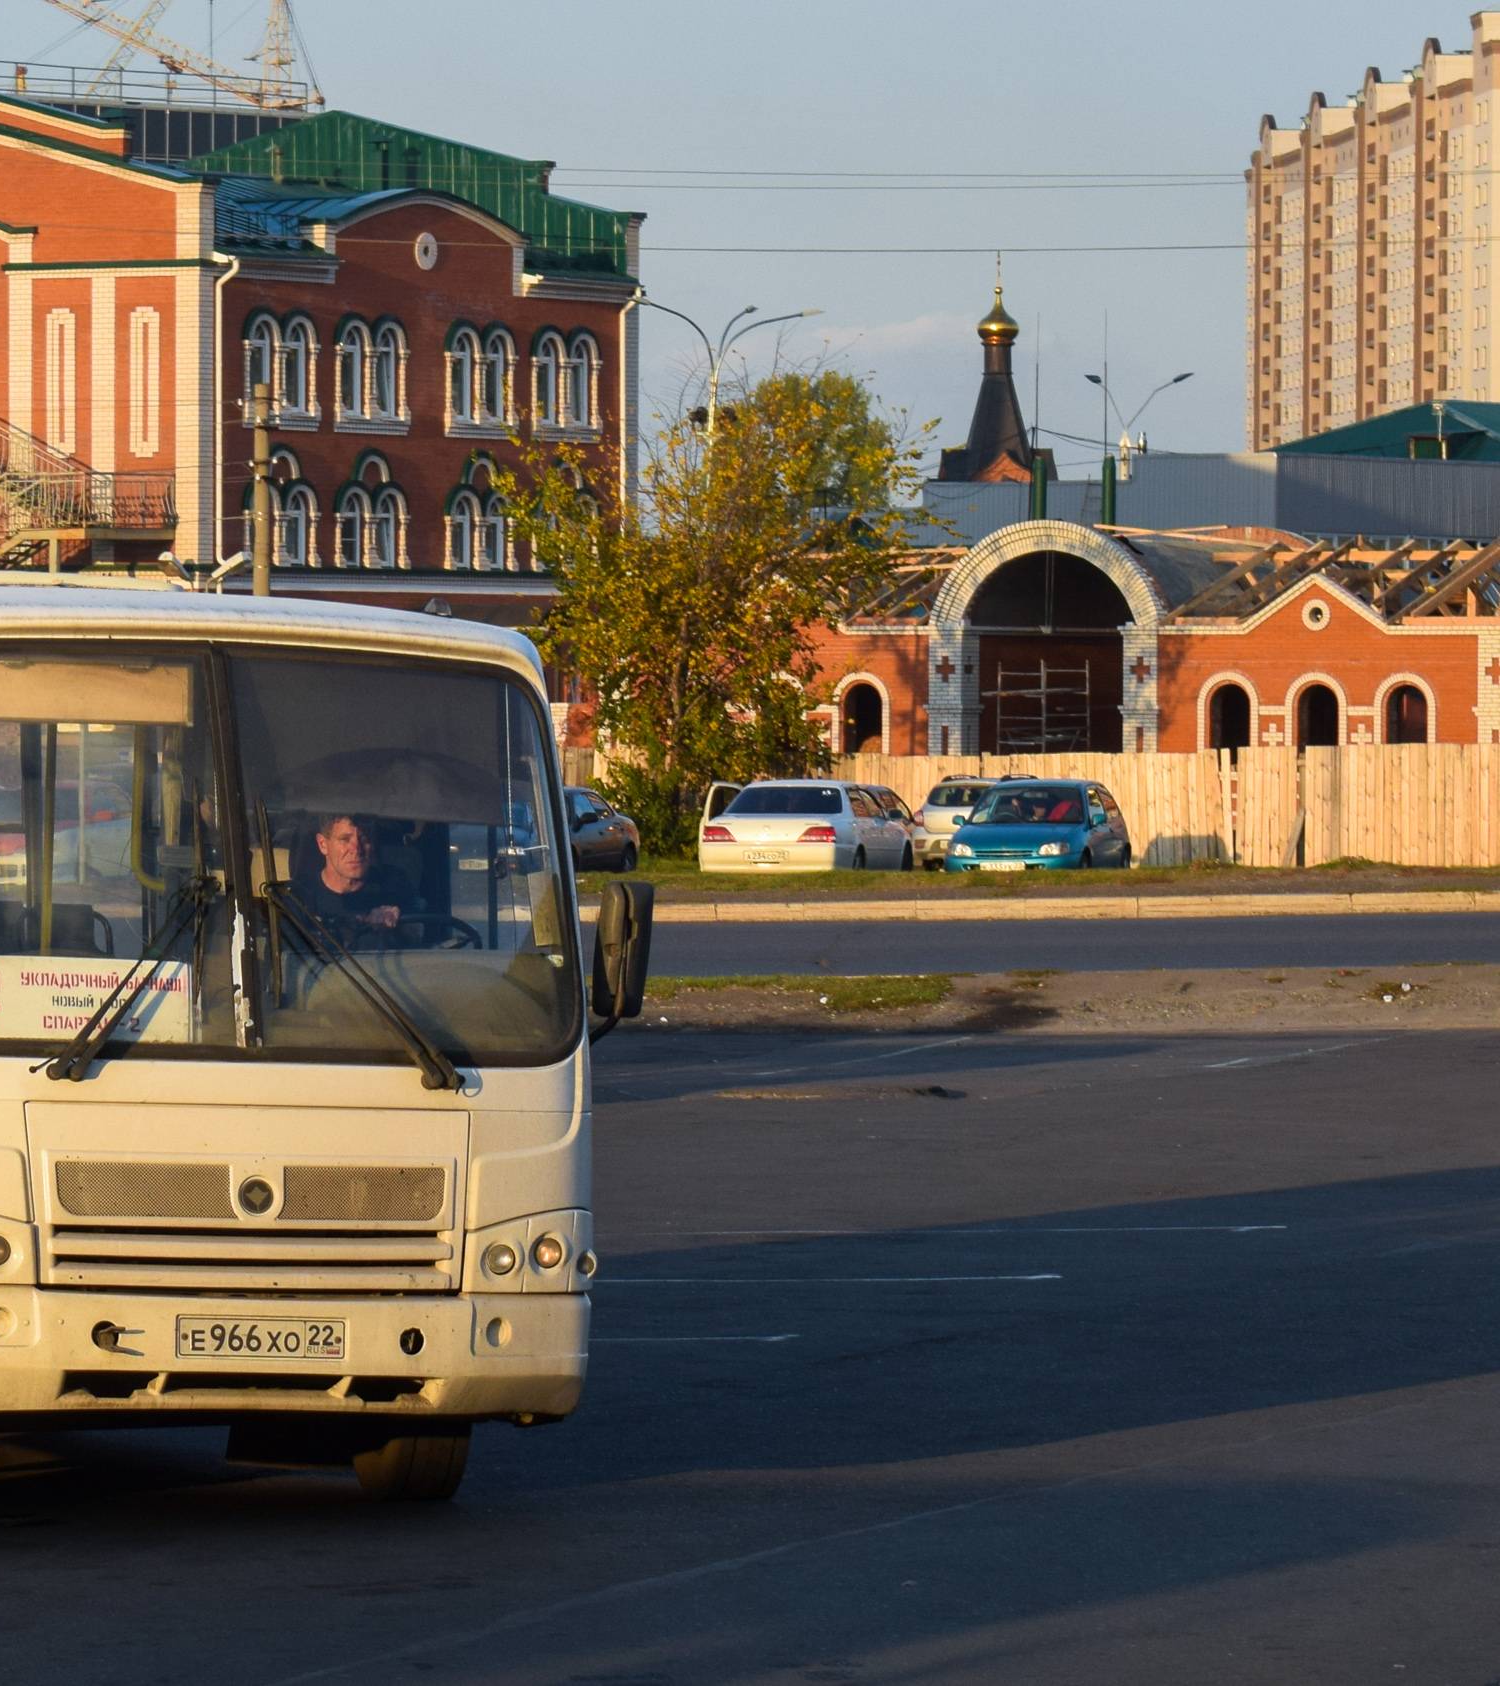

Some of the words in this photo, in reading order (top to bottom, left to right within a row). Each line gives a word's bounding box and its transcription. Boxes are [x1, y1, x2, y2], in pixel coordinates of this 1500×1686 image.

[21, 972, 119, 990] УКЛАДОЧНЫЙ
[52, 994, 94, 1008] НОВЫЙ
[307, 1324, 335, 1346] 22
[306, 1346, 326, 1354] RUS
